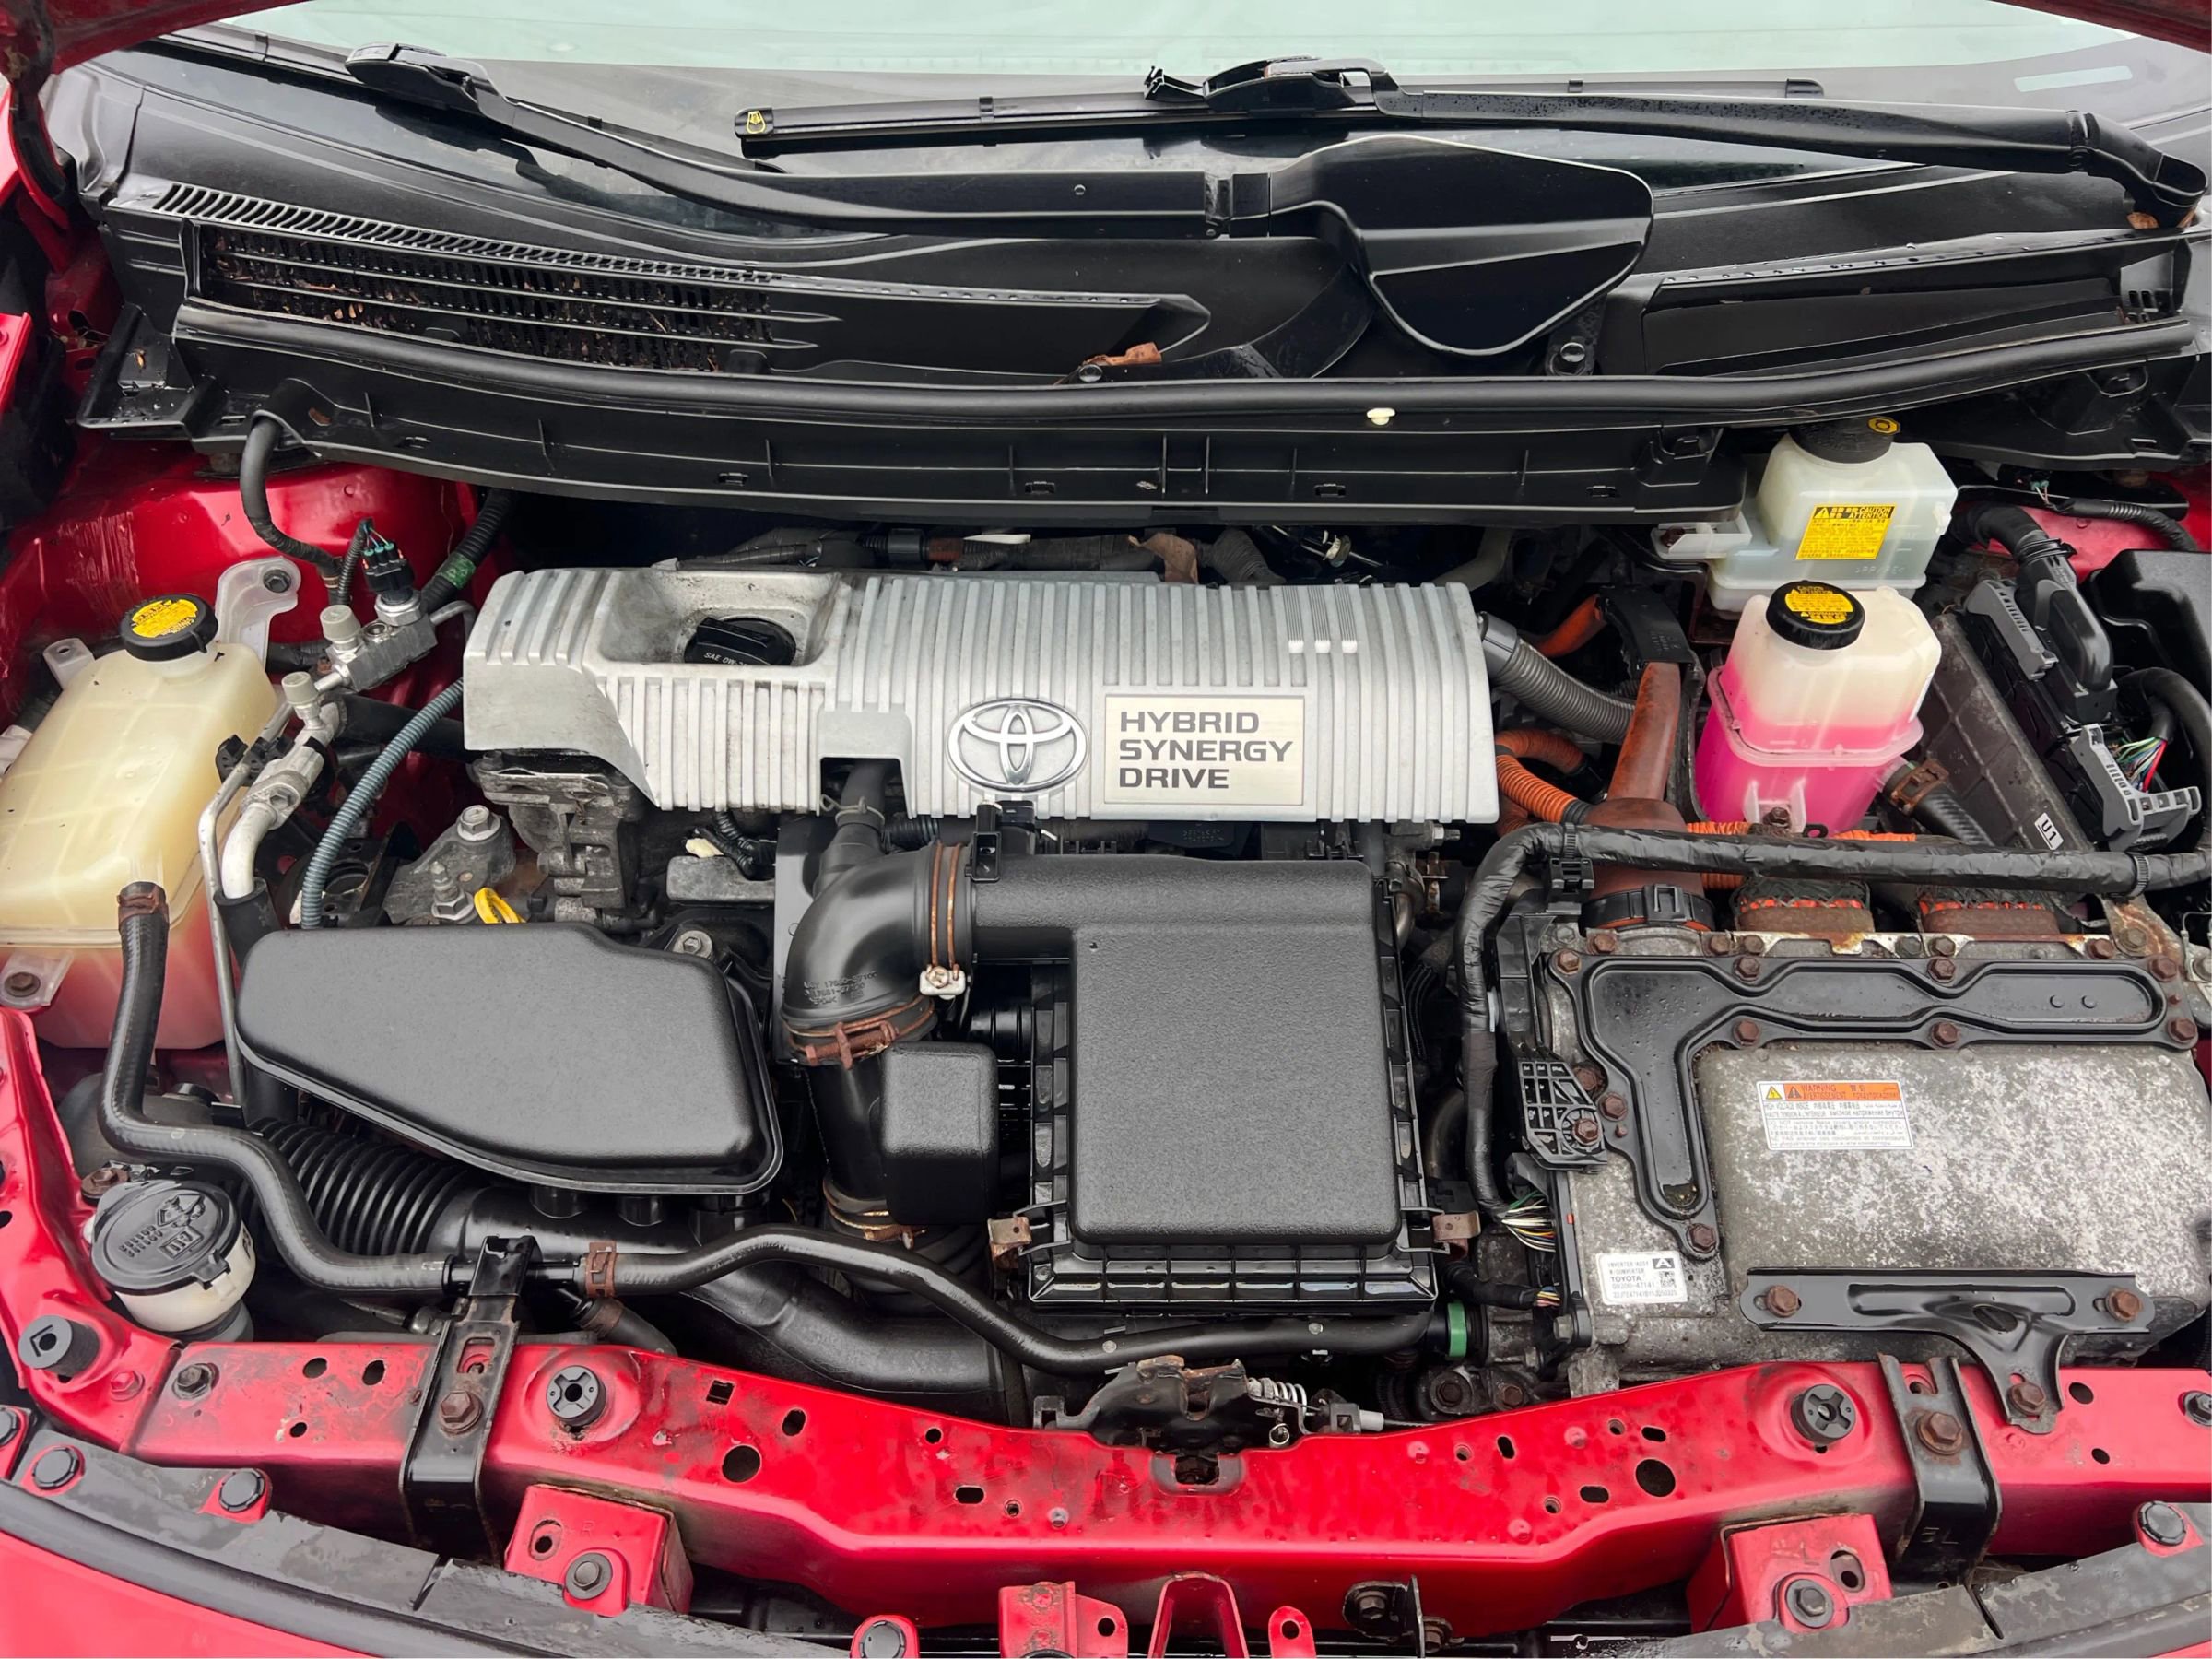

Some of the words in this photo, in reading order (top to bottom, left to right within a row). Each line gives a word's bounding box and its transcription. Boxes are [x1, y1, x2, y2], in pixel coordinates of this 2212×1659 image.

[703, 652, 721, 661] SAE
[1120, 711, 1259, 734] HYBRID
[1119, 739, 1293, 762] SYNERGY
[1119, 767, 1230, 789] DRIVE
[2041, 818, 2057, 841] U1
[1610, 1275, 1642, 1283] TOYOTA
